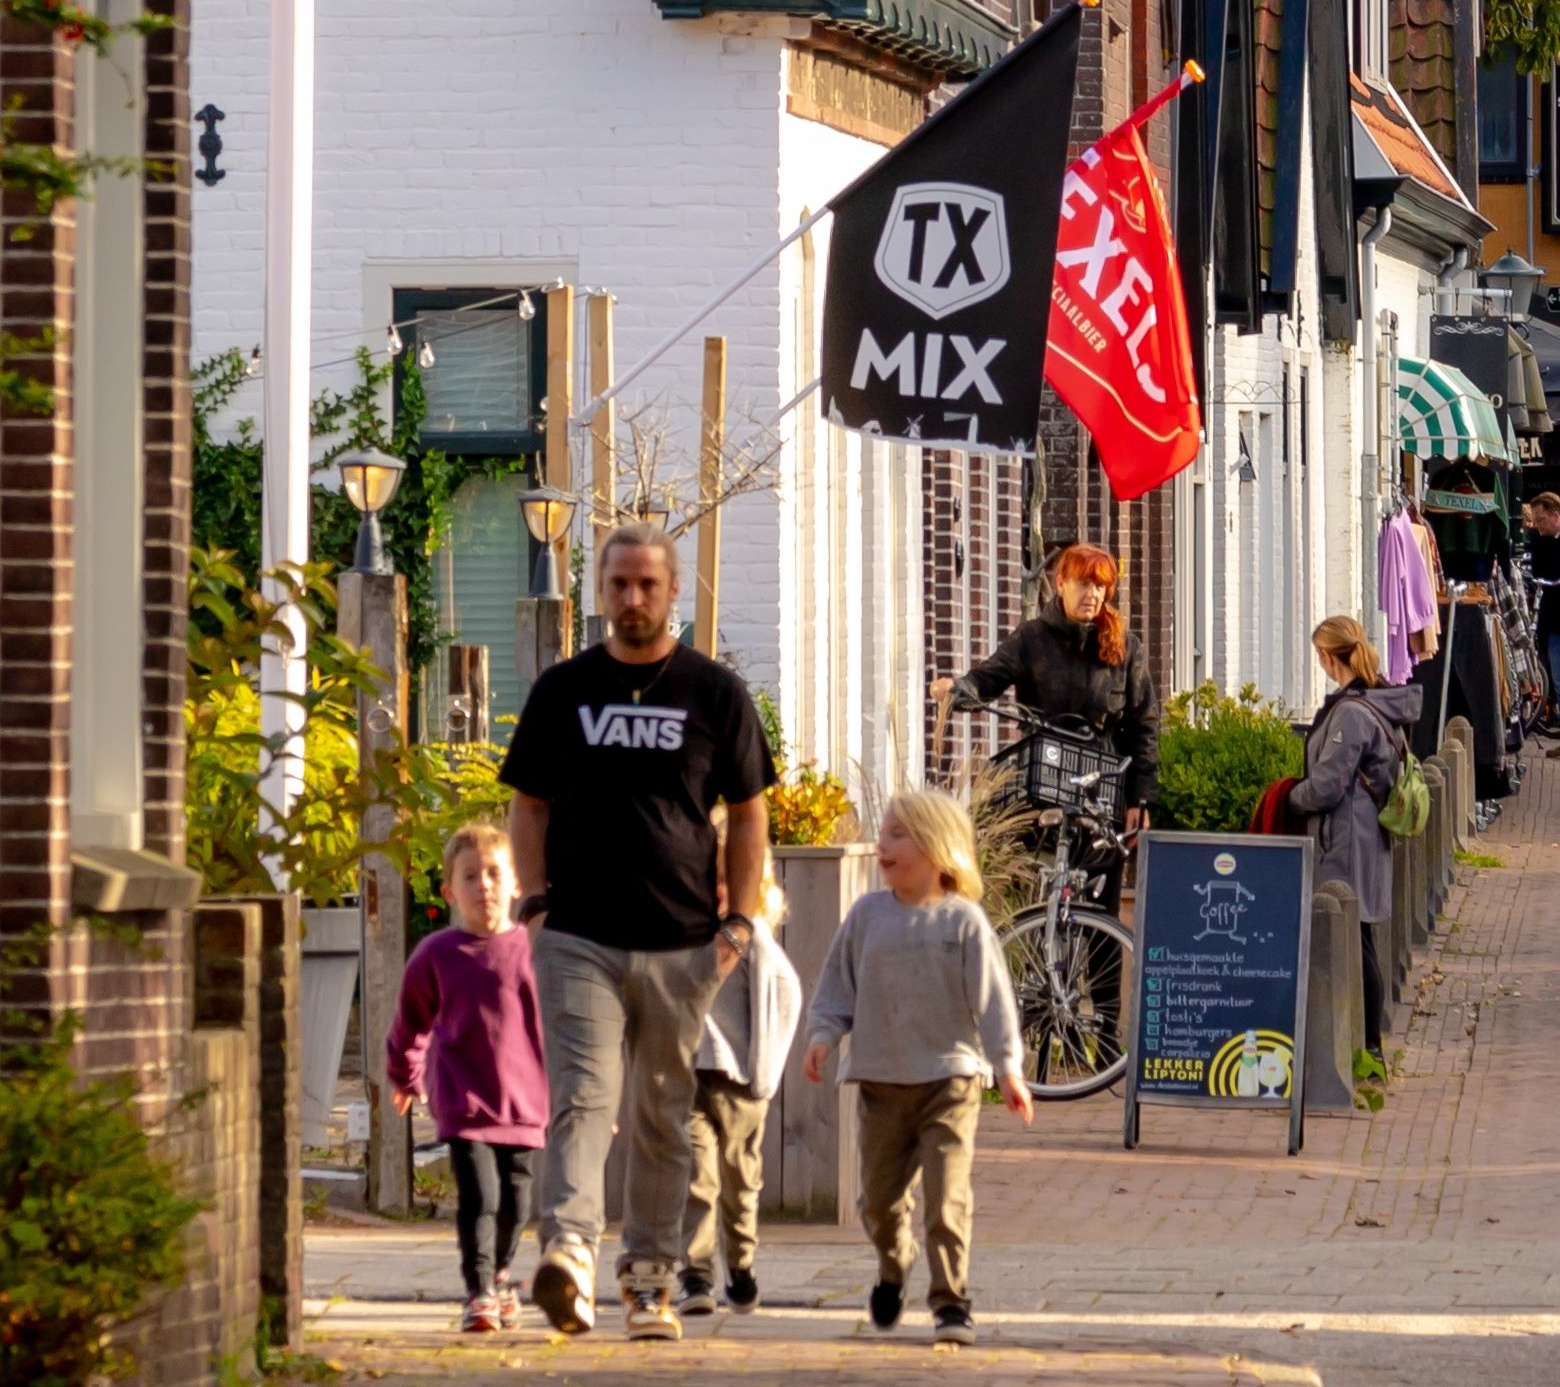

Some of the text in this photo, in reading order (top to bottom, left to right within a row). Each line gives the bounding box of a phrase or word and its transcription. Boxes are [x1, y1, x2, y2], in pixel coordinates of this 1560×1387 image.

[902, 201, 992, 288] TX
[1051, 279, 1108, 355] CIAALBIER
[849, 326, 1008, 406] MIX
[577, 703, 689, 752] VANS
[1166, 978, 1222, 995] frisdrank
[1166, 995, 1254, 1013] bittergarnituur
[1164, 1024, 1233, 1043] hamburgers
[1144, 1058, 1204, 1070] LEKKER
